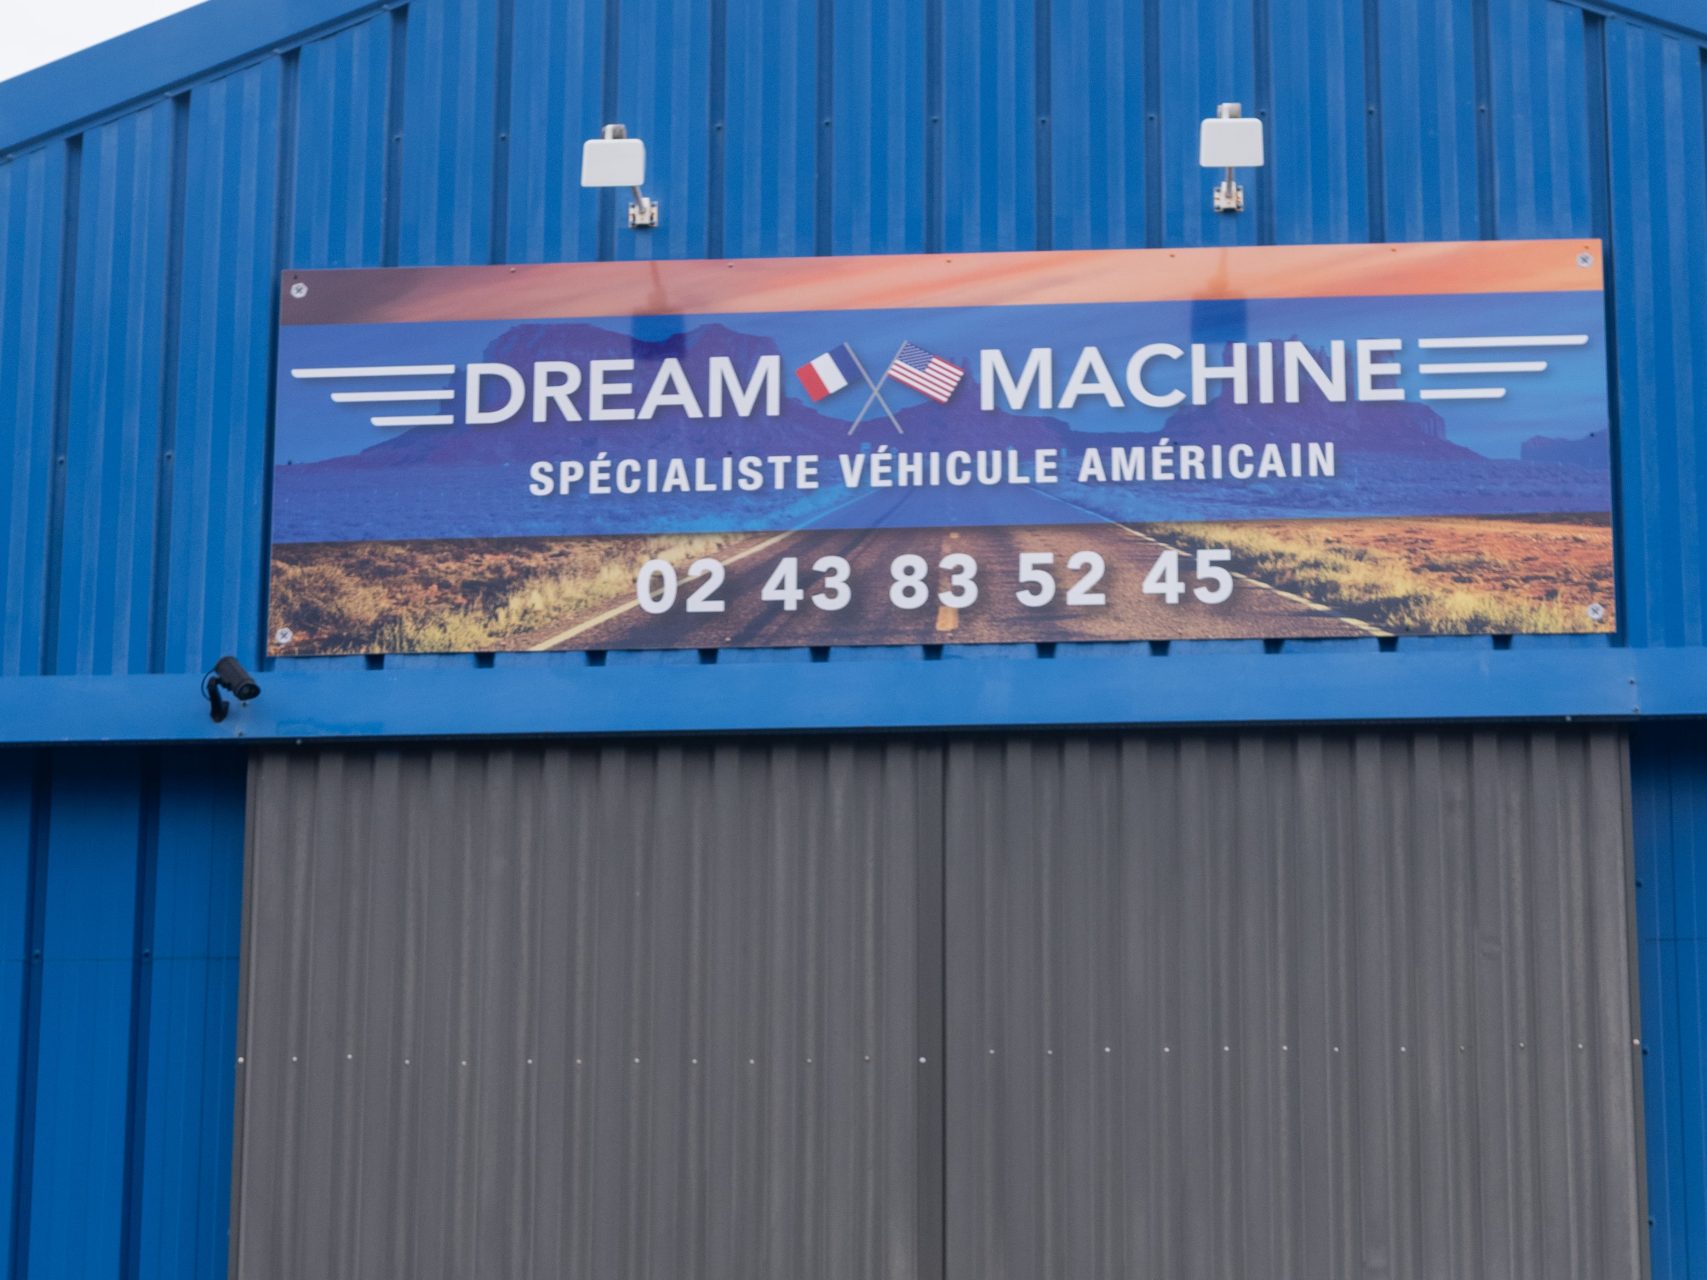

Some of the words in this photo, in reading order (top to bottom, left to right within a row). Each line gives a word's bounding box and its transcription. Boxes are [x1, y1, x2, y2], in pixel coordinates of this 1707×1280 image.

[464, 354, 781, 425] DREAM
[979, 338, 1406, 411] MACHINE
[529, 452, 820, 496] SPÉCIALISTE
[838, 444, 1059, 488] VÉHICULE
[1077, 437, 1336, 483] AMÉRICAIN
[636, 557, 726, 614] 02
[761, 555, 852, 611] 43
[888, 552, 979, 610] 83
[1014, 550, 1107, 608] 52
[1140, 547, 1235, 604] 45
